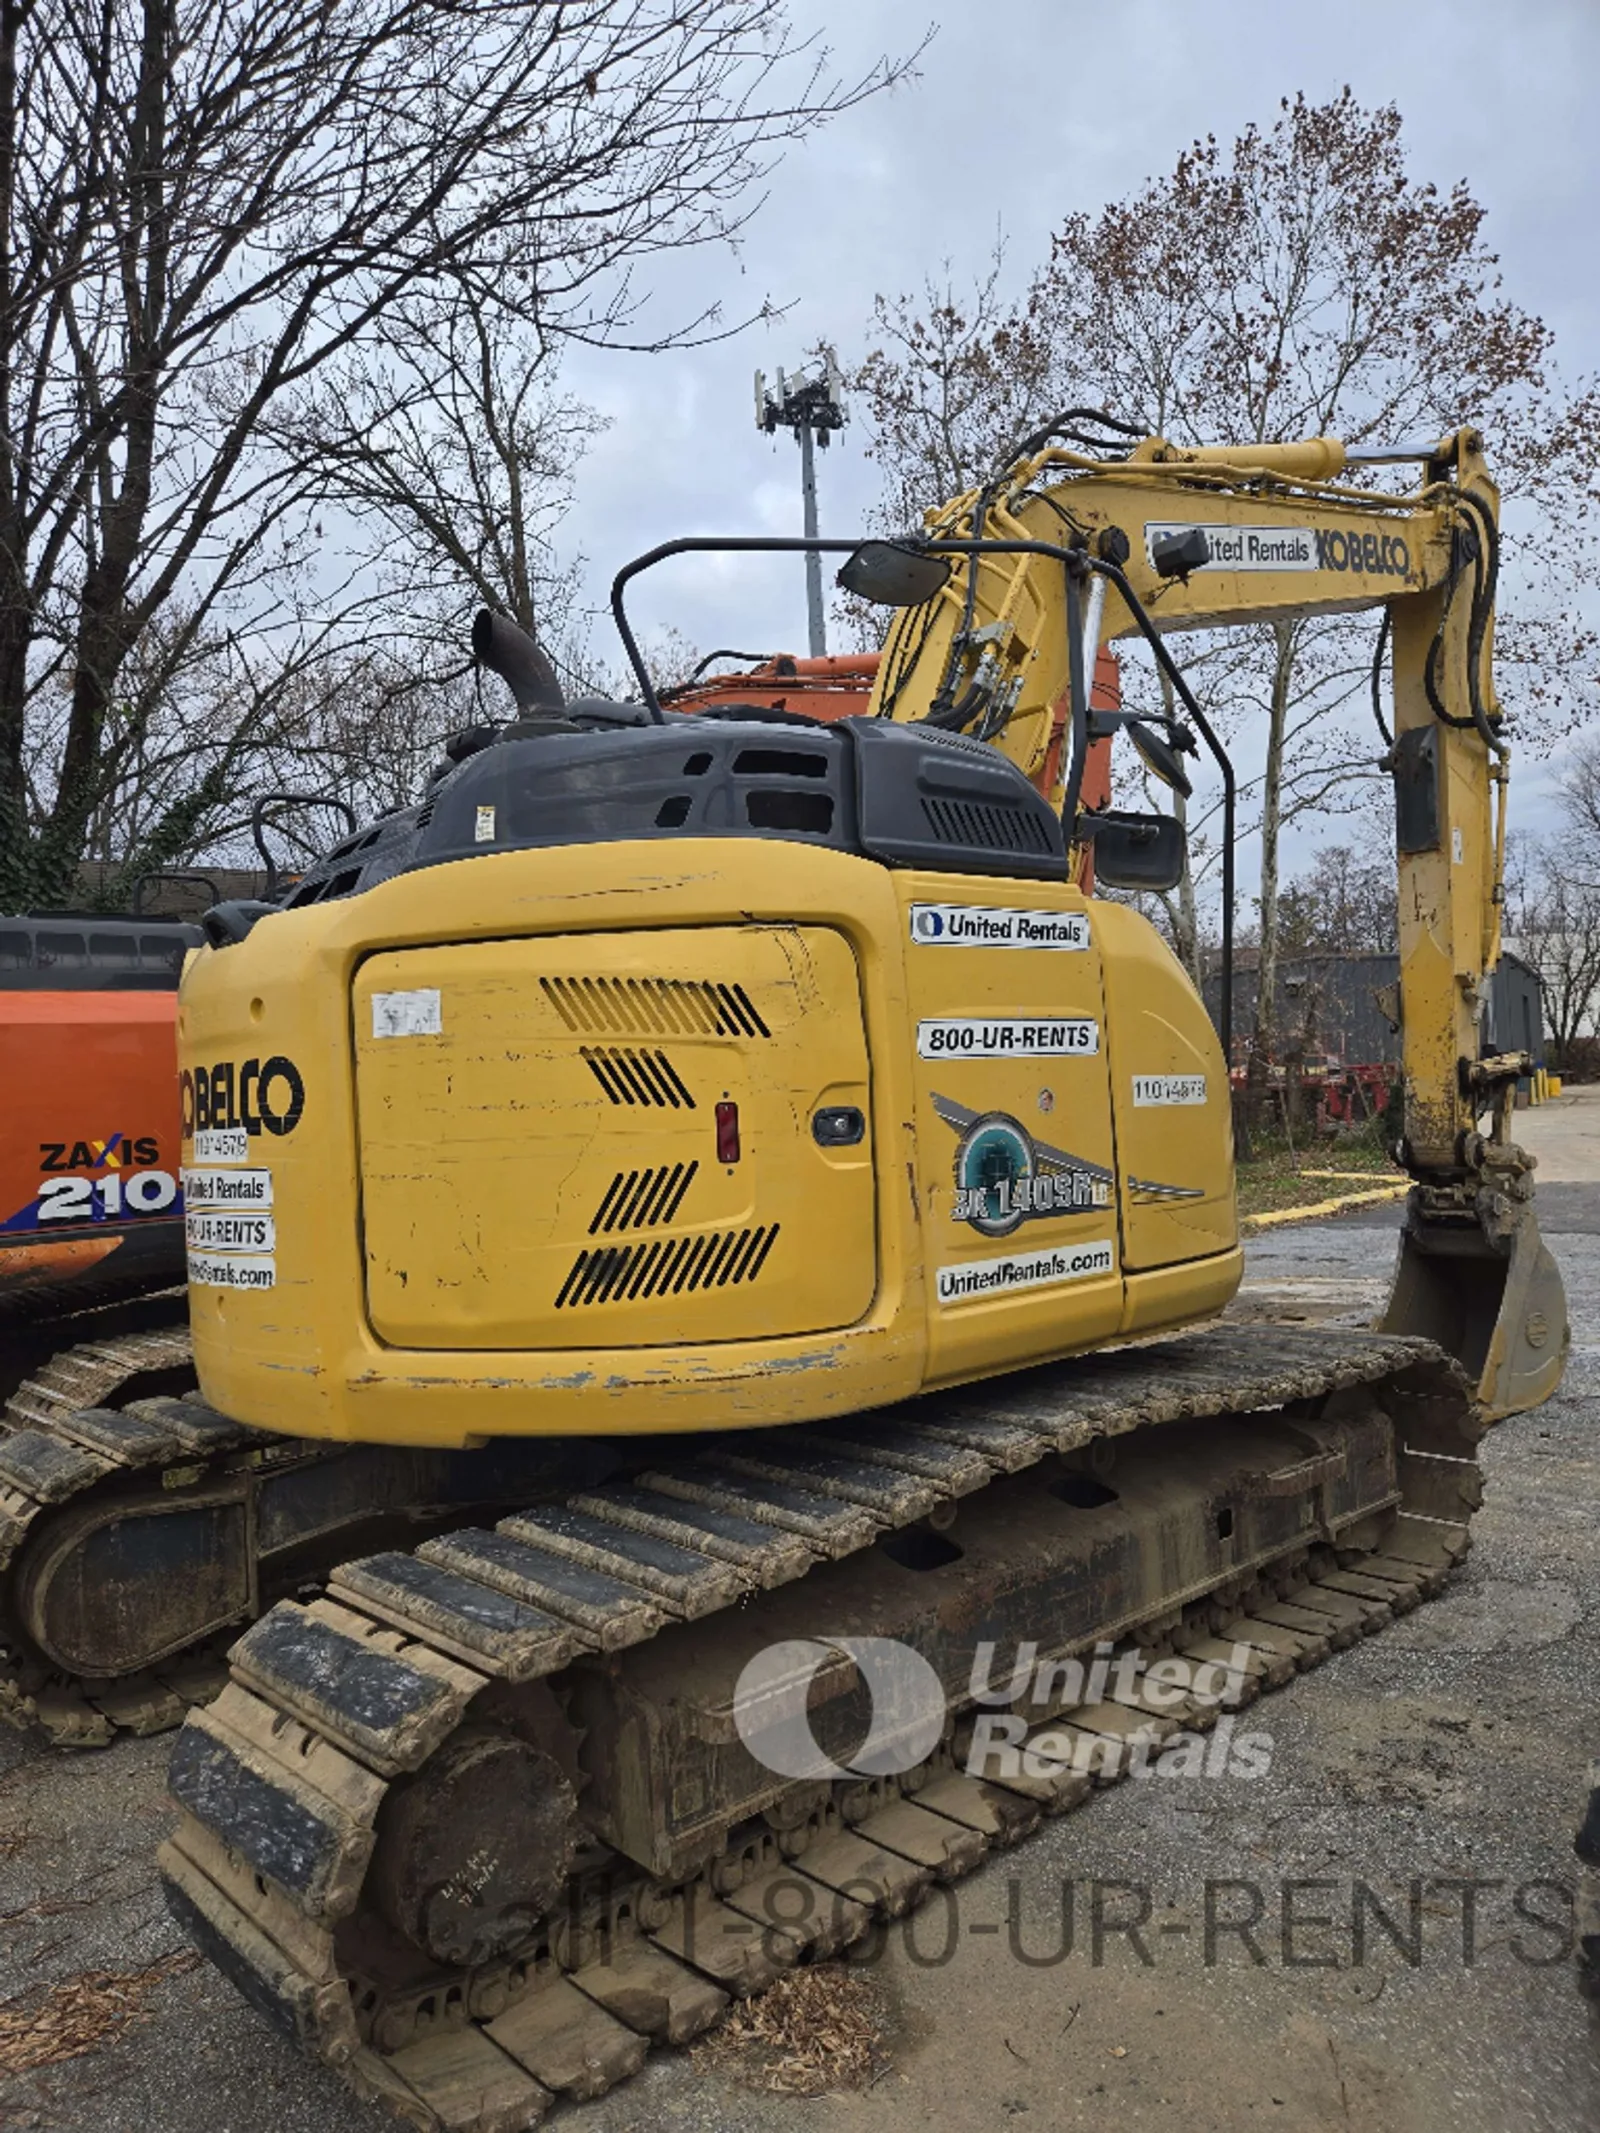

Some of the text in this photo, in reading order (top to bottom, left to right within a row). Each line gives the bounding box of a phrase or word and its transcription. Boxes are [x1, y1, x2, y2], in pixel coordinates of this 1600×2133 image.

[1207, 534, 1310, 562] ited Rentals
[1314, 528, 1410, 576] KOBELCO
[949, 914, 1082, 942] United Rentals
[929, 1025, 1090, 1050] 800-UR-RENTS
[179, 1055, 305, 1140] OBELCO
[40, 1132, 160, 1171] ZAXIS
[37, 1170, 176, 1220] 210
[216, 1176, 264, 1199] Rentals
[940, 1249, 1110, 1298] UnitedRentals.com
